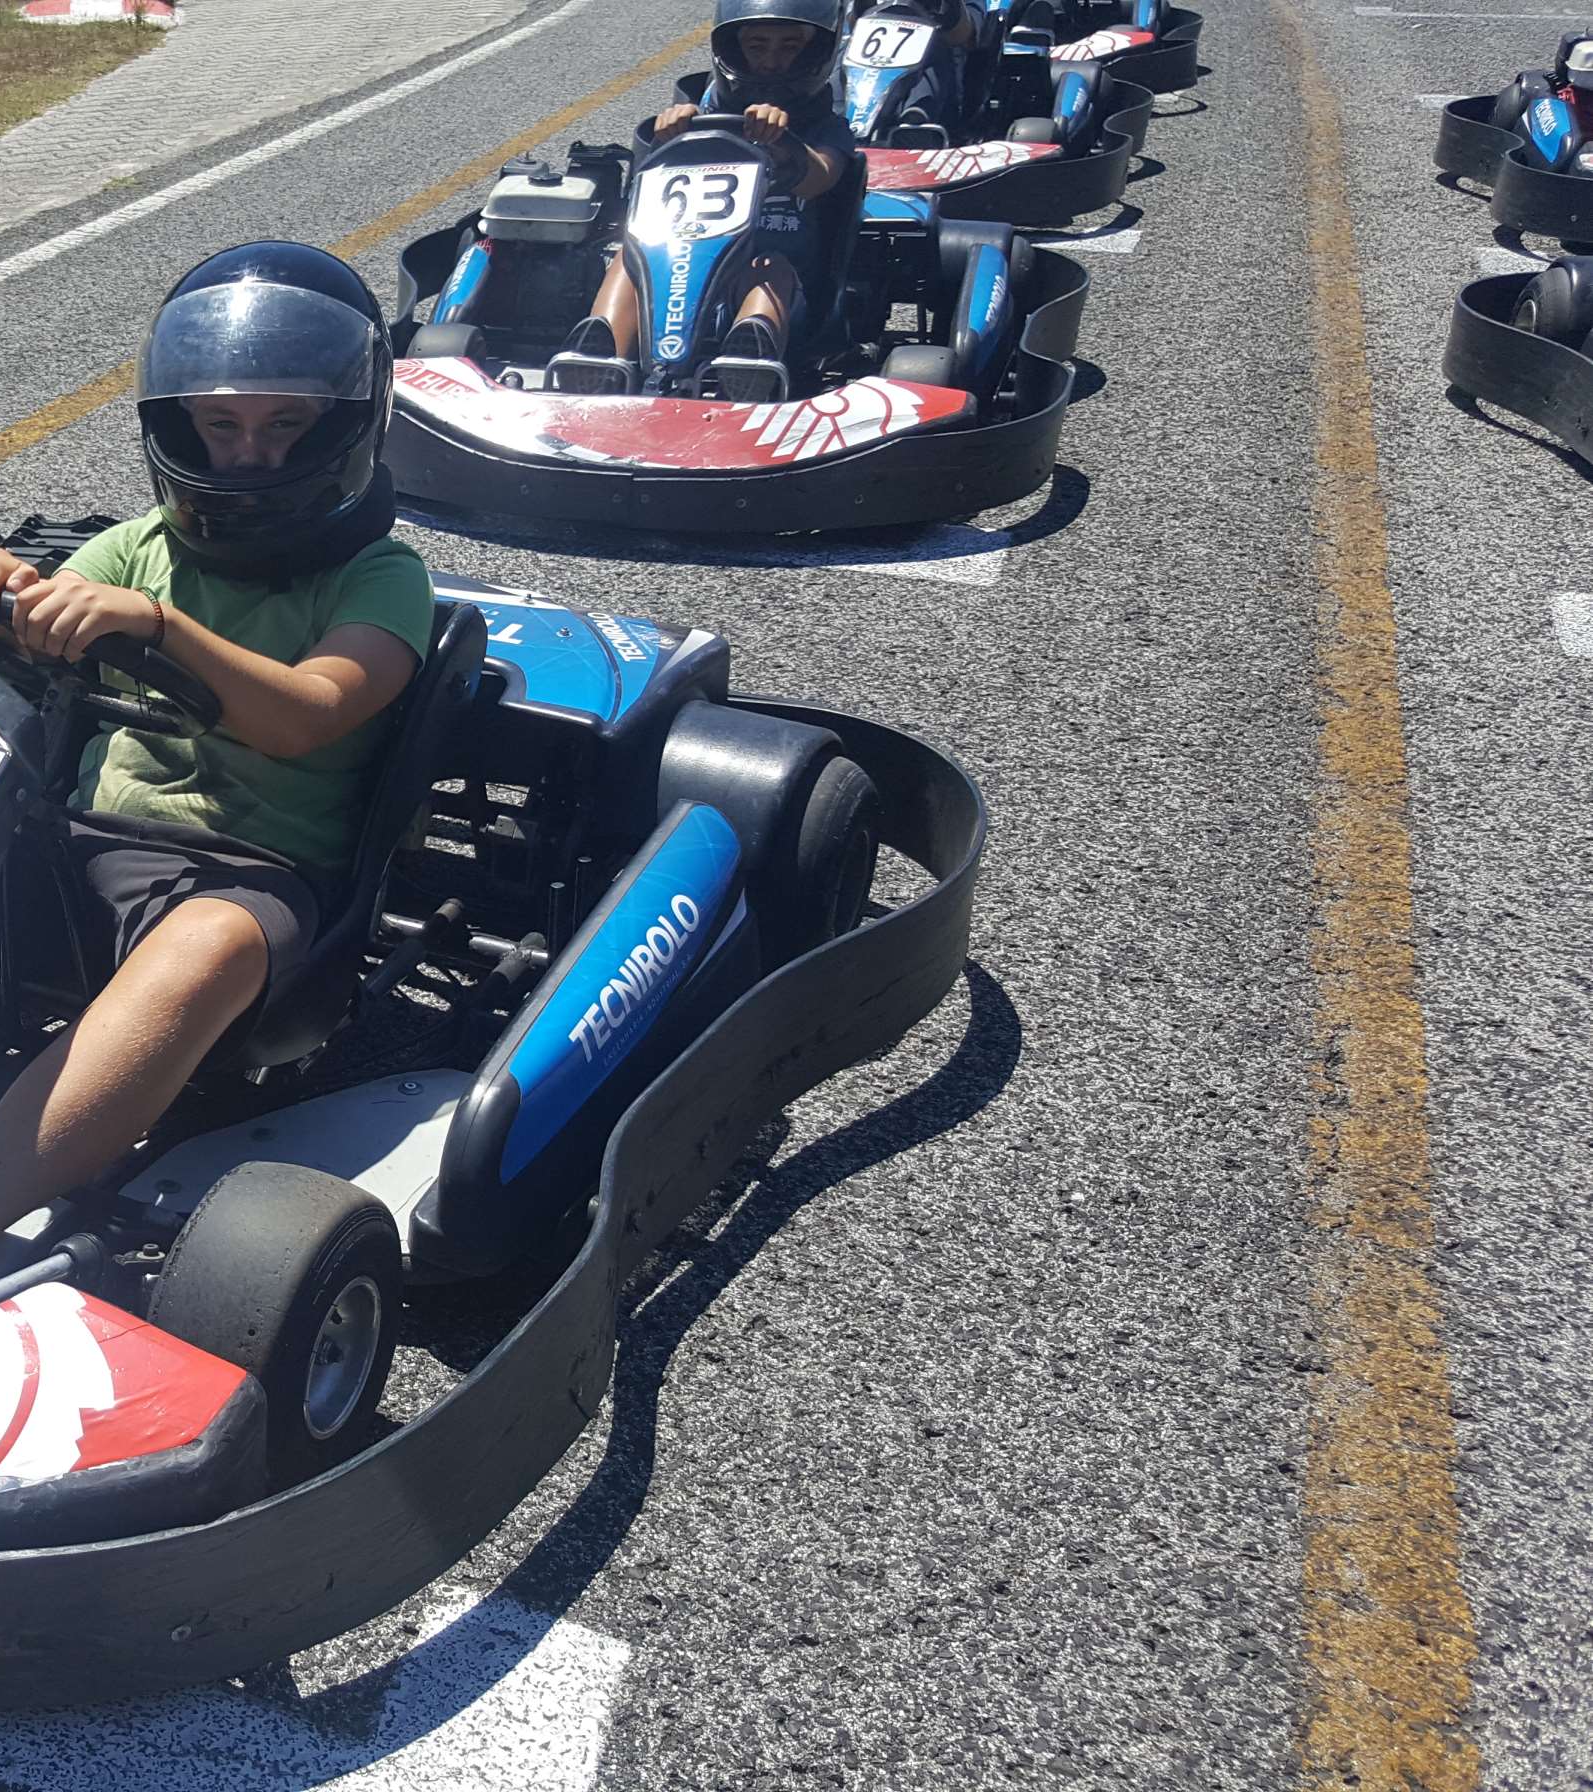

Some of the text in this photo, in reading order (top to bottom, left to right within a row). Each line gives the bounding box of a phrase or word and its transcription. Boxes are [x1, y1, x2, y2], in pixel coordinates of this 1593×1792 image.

[861, 26, 915, 59] 67
[661, 173, 740, 223] 63
[587, 612, 647, 662] TECNIROLO
[568, 894, 700, 1064] TECNIROLO
